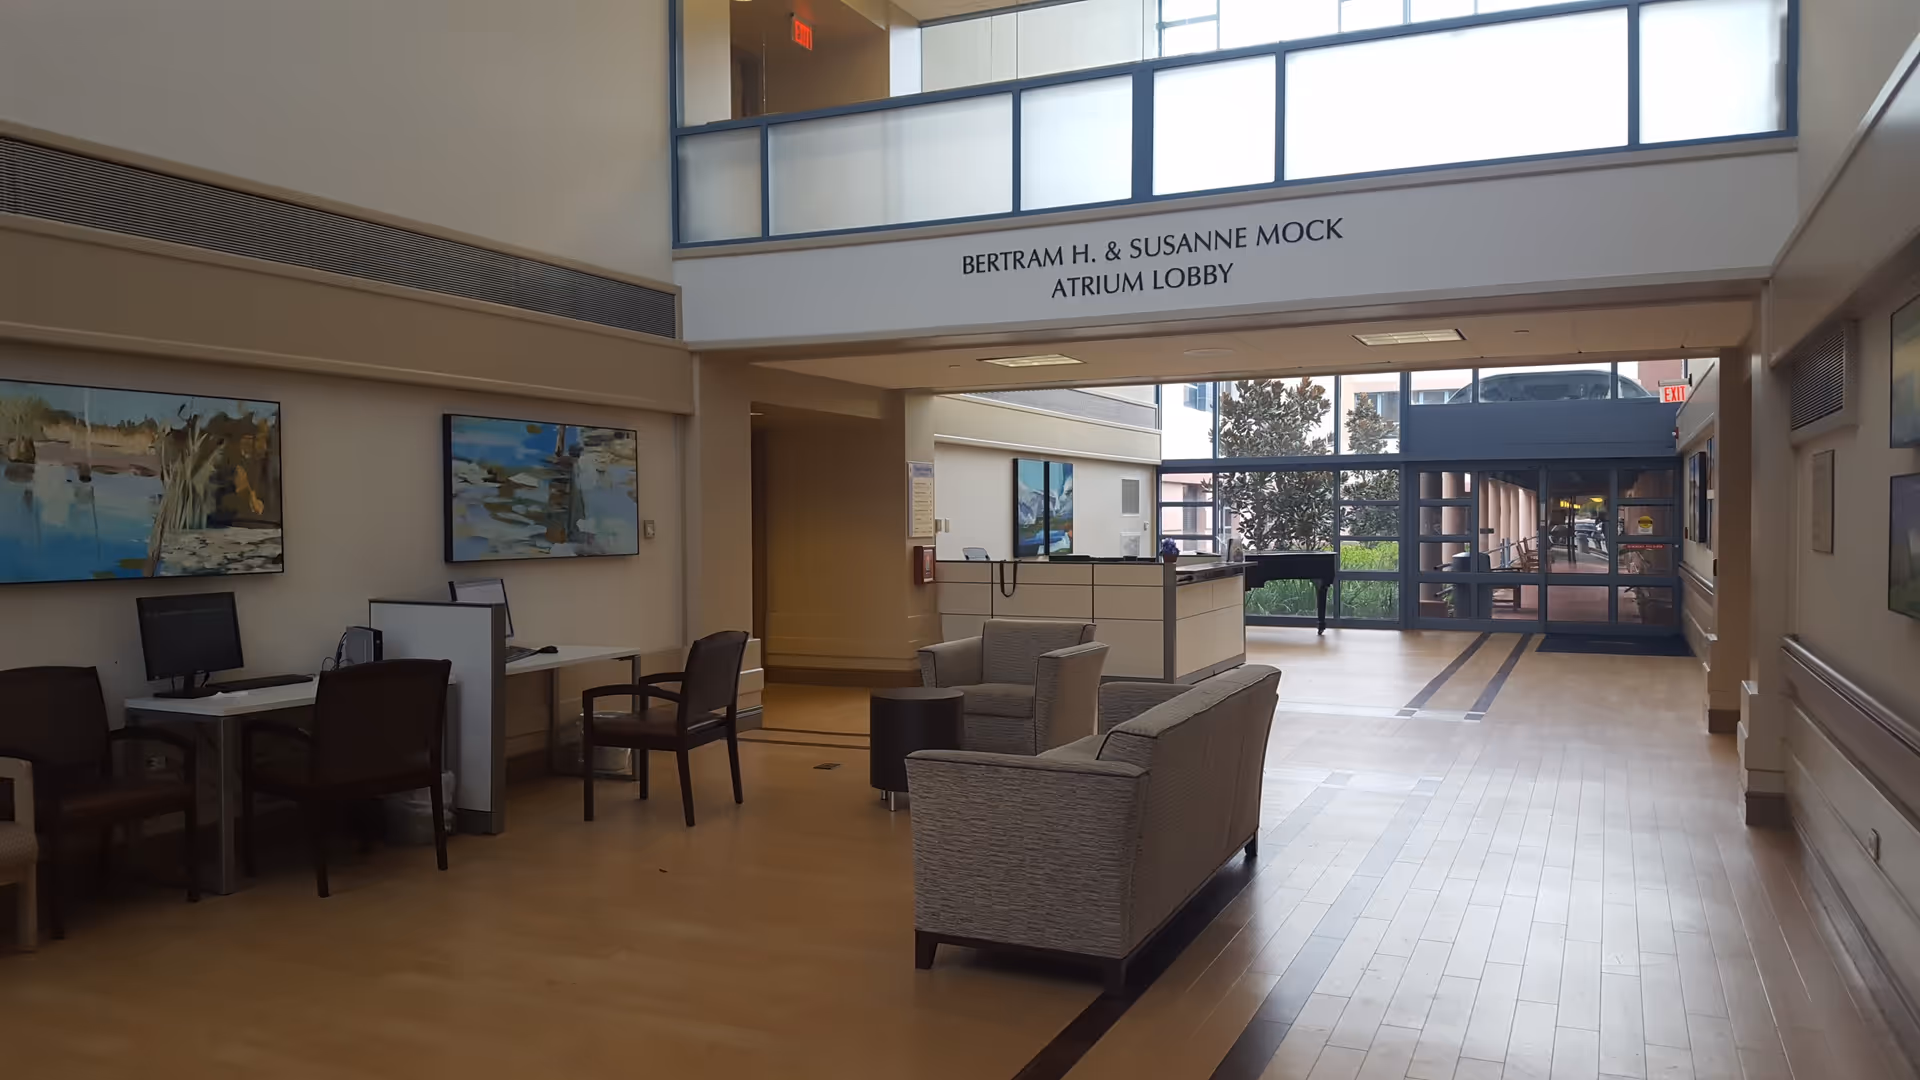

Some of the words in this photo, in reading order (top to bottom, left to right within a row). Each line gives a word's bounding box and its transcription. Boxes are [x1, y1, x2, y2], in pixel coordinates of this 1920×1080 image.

[962, 243, 1064, 275] BERTRAM
[1072, 243, 1096, 265] H.
[1104, 240, 1122, 262] &
[1129, 226, 1247, 259] SUSANNE
[1256, 217, 1343, 247] MOCK
[1051, 270, 1144, 299] ATRIUM
[1153, 262, 1234, 290] LOBBY
[1664, 386, 1686, 403] EXIT
